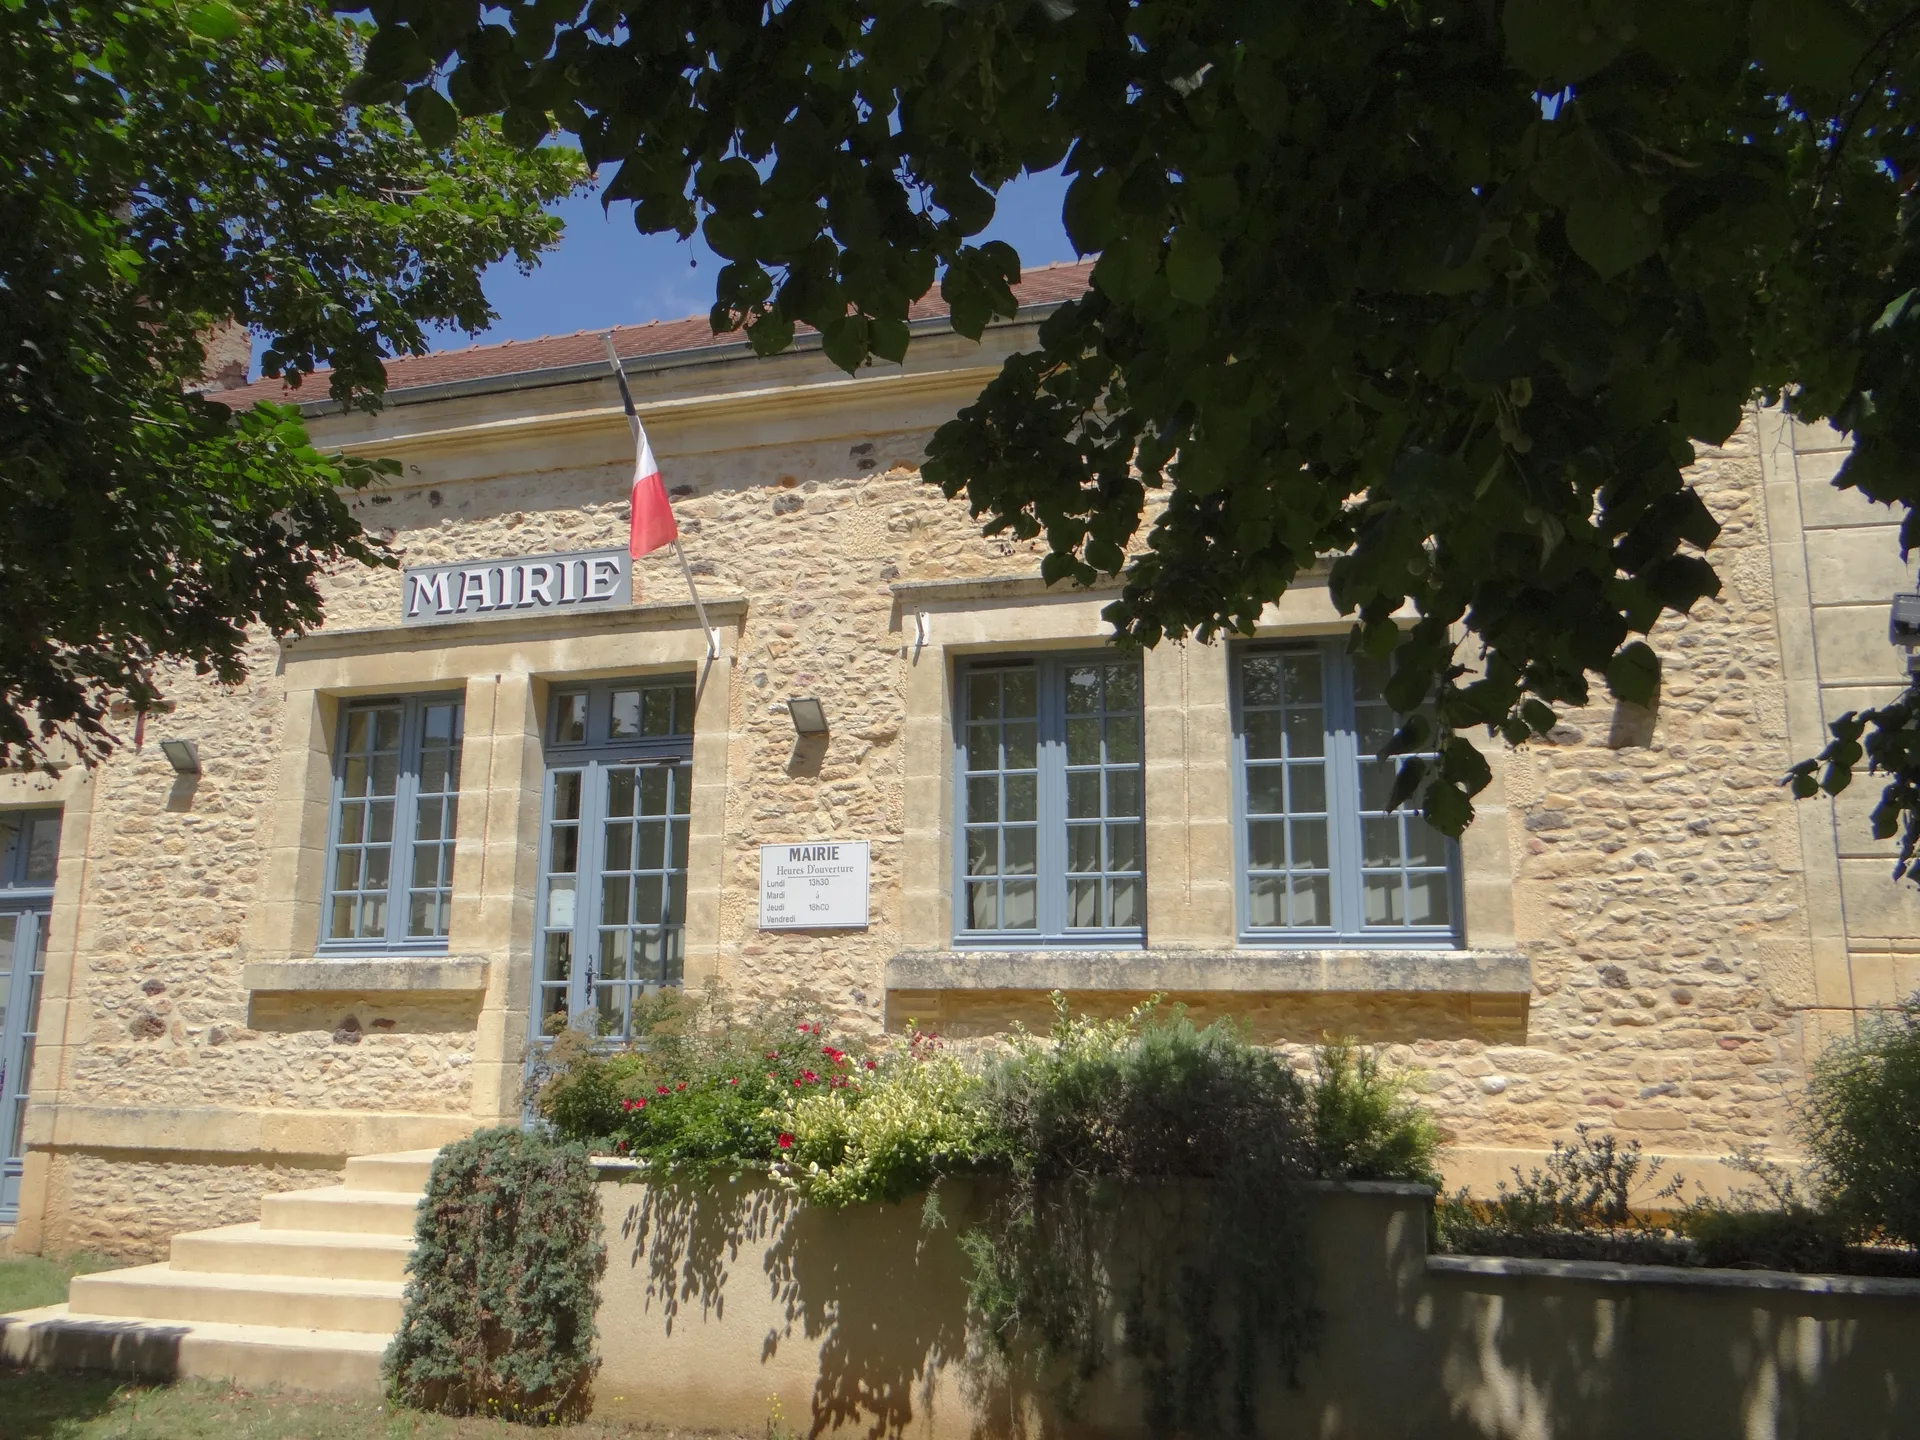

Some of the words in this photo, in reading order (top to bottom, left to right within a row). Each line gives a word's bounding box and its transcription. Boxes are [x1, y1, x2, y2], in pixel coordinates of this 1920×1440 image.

[408, 556, 622, 617] MAIRIE
[789, 846, 840, 862] MAIRIE
[776, 865, 804, 875] Heures
[807, 864, 854, 874] D'ouverture
[766, 880, 785, 888] Lundi
[808, 878, 829, 886] 13h30
[766, 891, 785, 899] Mardi
[766, 915, 796, 923] Vendredi
